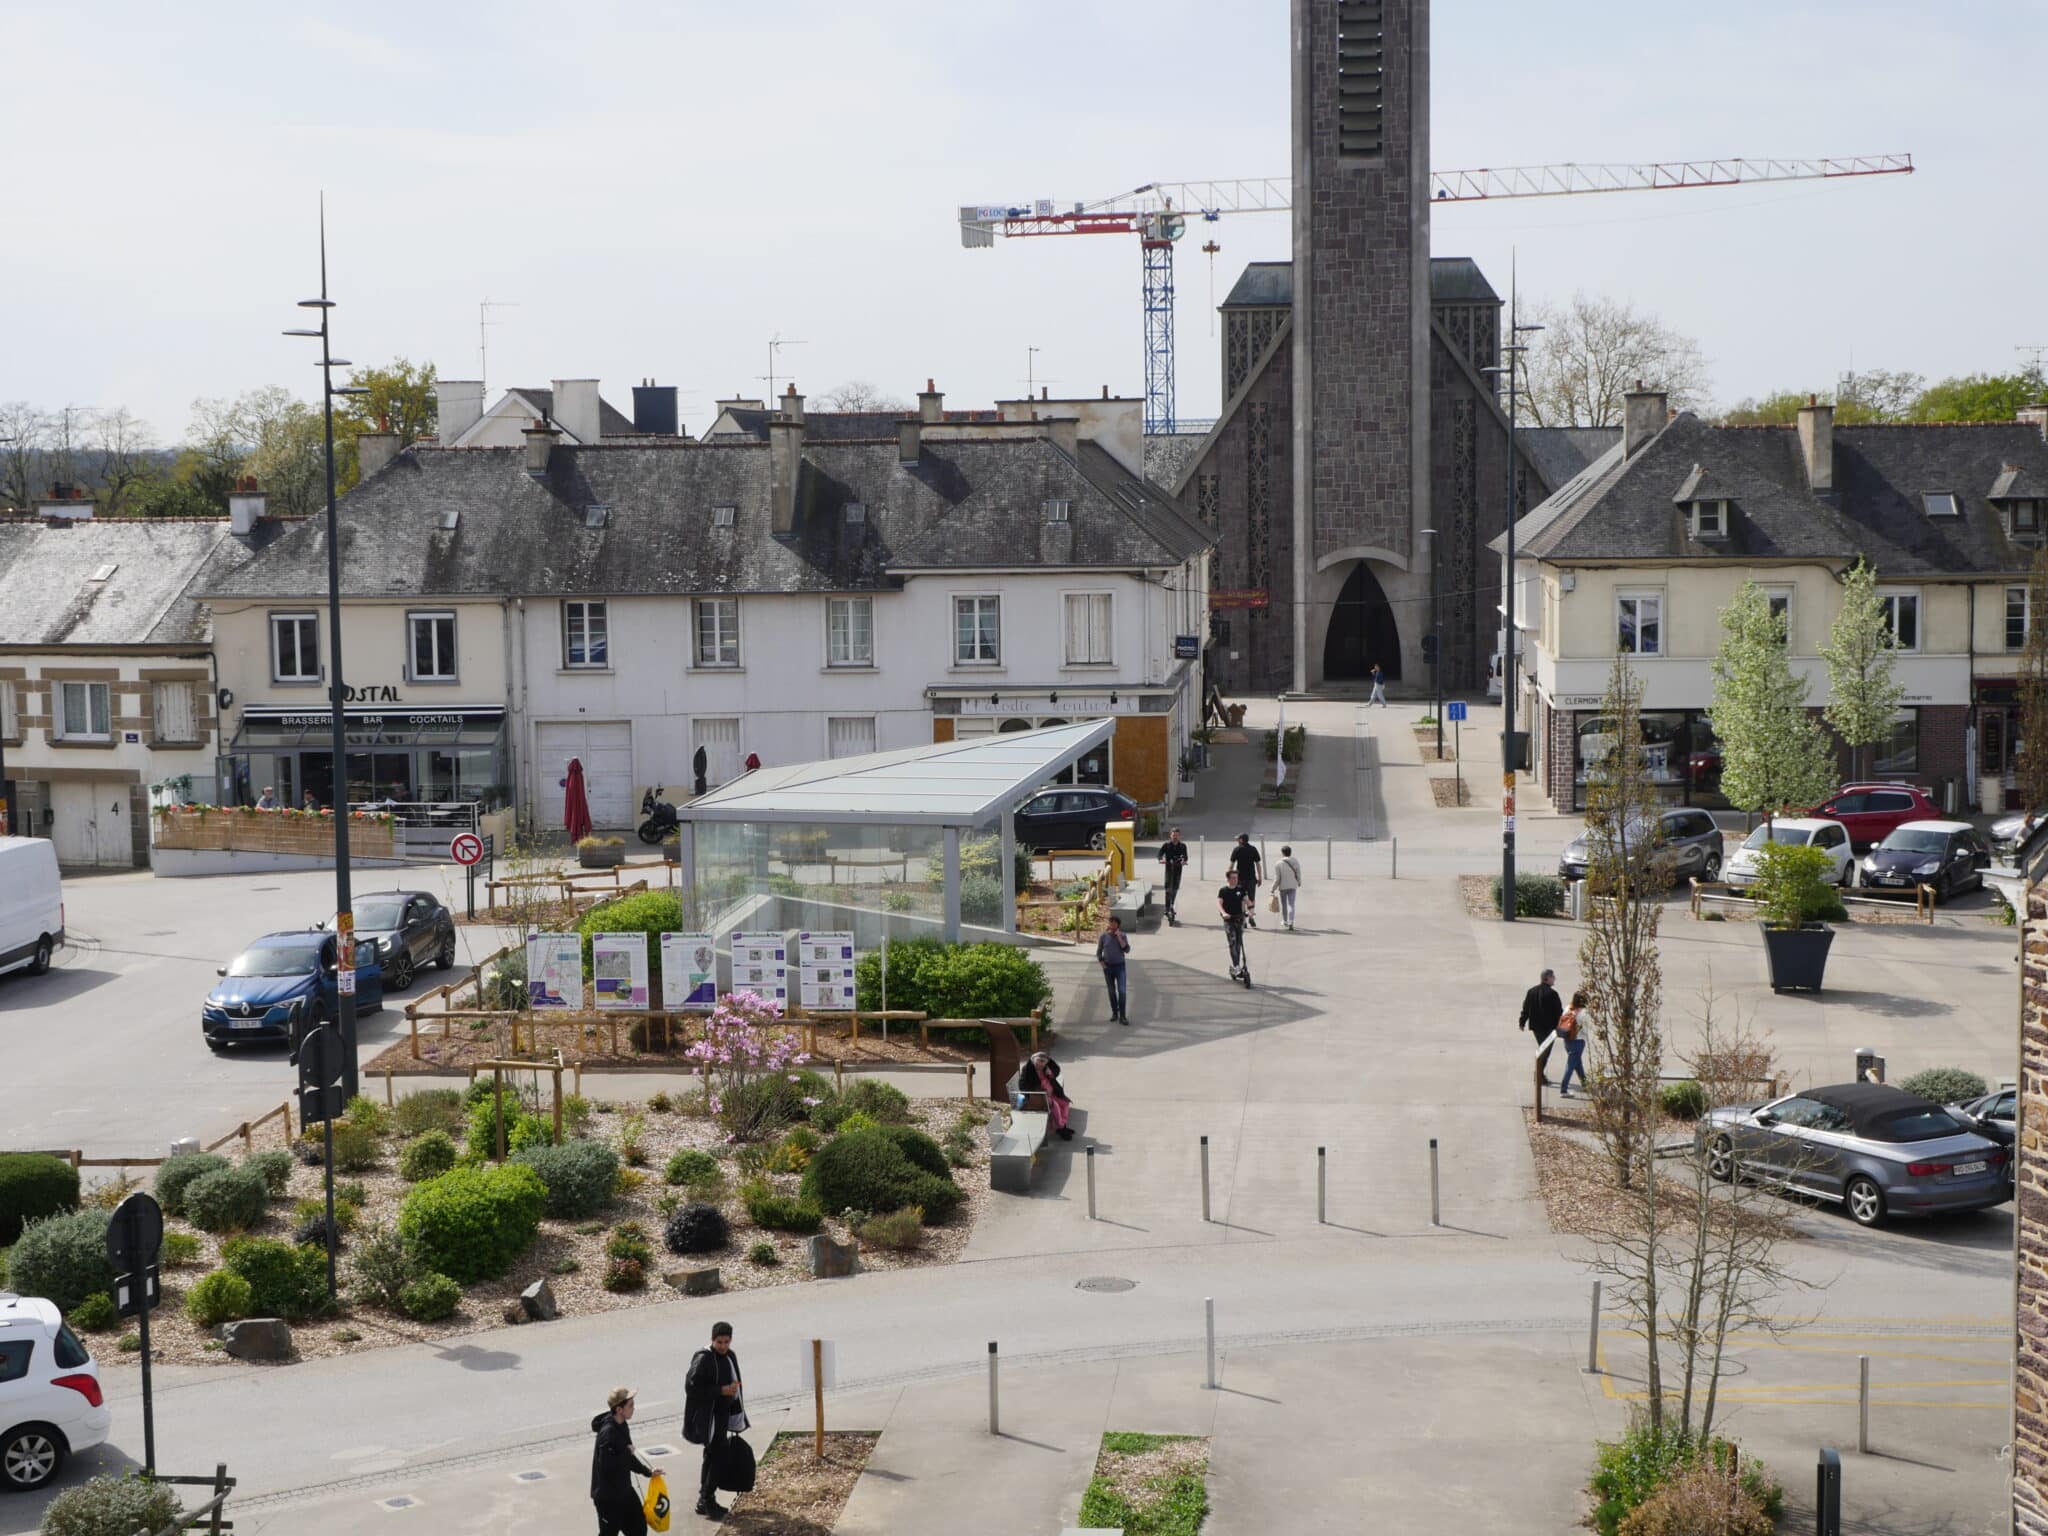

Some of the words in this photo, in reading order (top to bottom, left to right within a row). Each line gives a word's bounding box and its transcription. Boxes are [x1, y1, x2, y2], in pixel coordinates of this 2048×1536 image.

[328, 686, 403, 702] OSTAL
[362, 716, 383, 724] BAR
[408, 715, 464, 724] COCKTAILS
[111, 802, 119, 816] 4
